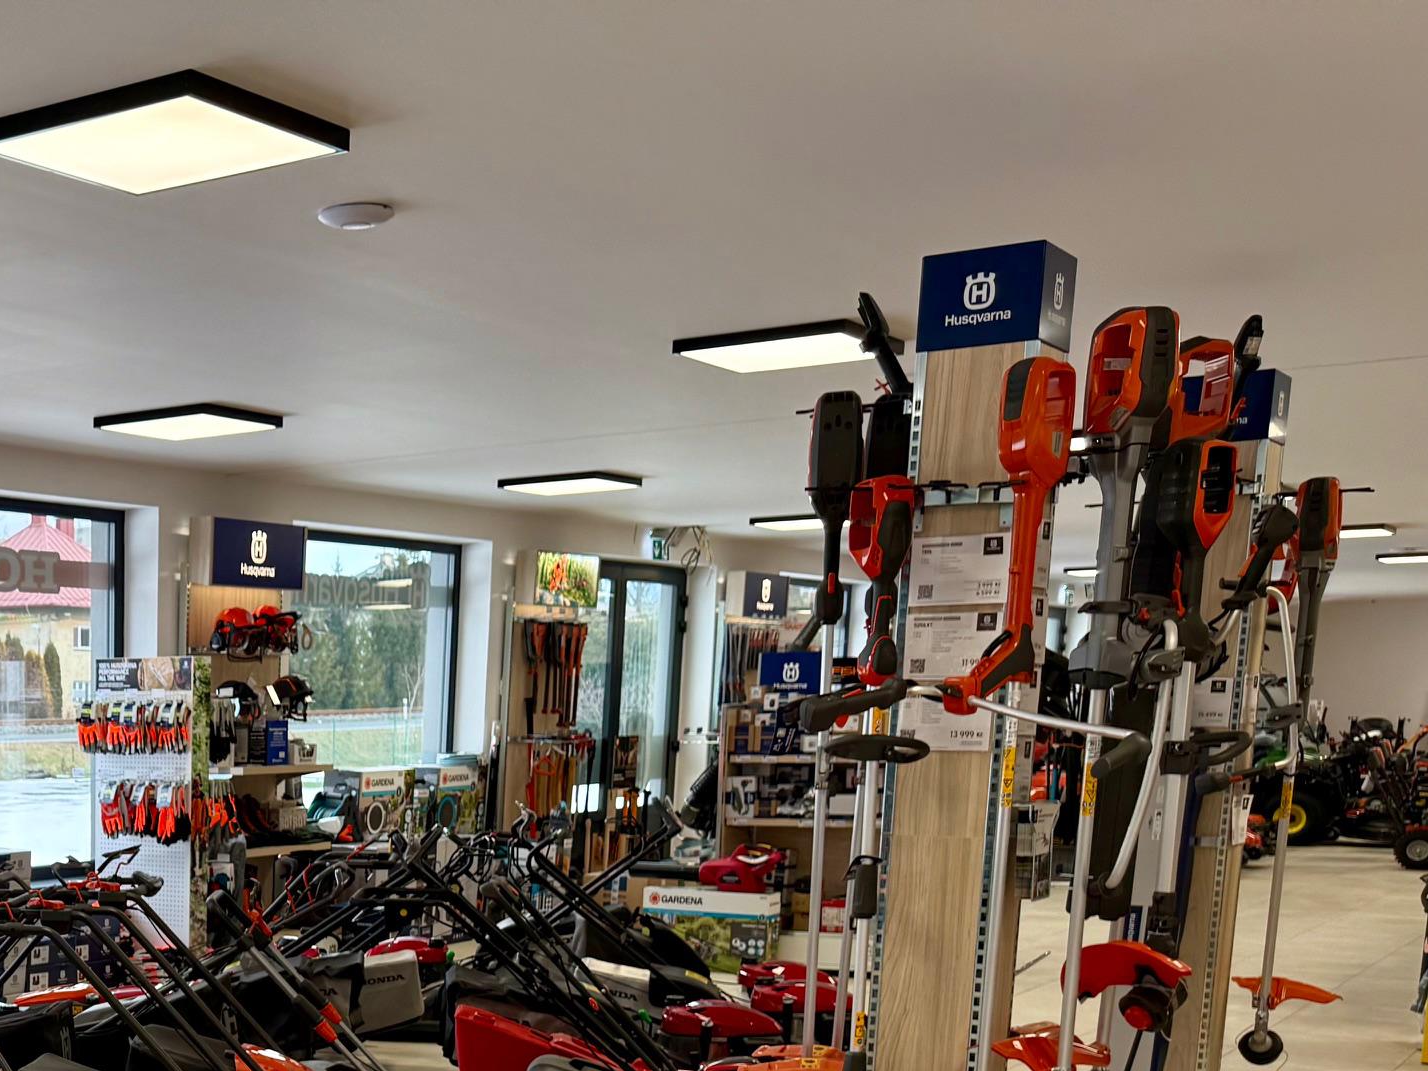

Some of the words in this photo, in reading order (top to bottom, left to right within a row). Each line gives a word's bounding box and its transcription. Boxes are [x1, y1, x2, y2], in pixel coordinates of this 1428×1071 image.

[944, 309, 1012, 327] Husqvarna
[240, 562, 276, 578] Husqvarna
[661, 895, 703, 906] GARDENA
[363, 974, 405, 986] ONDA
